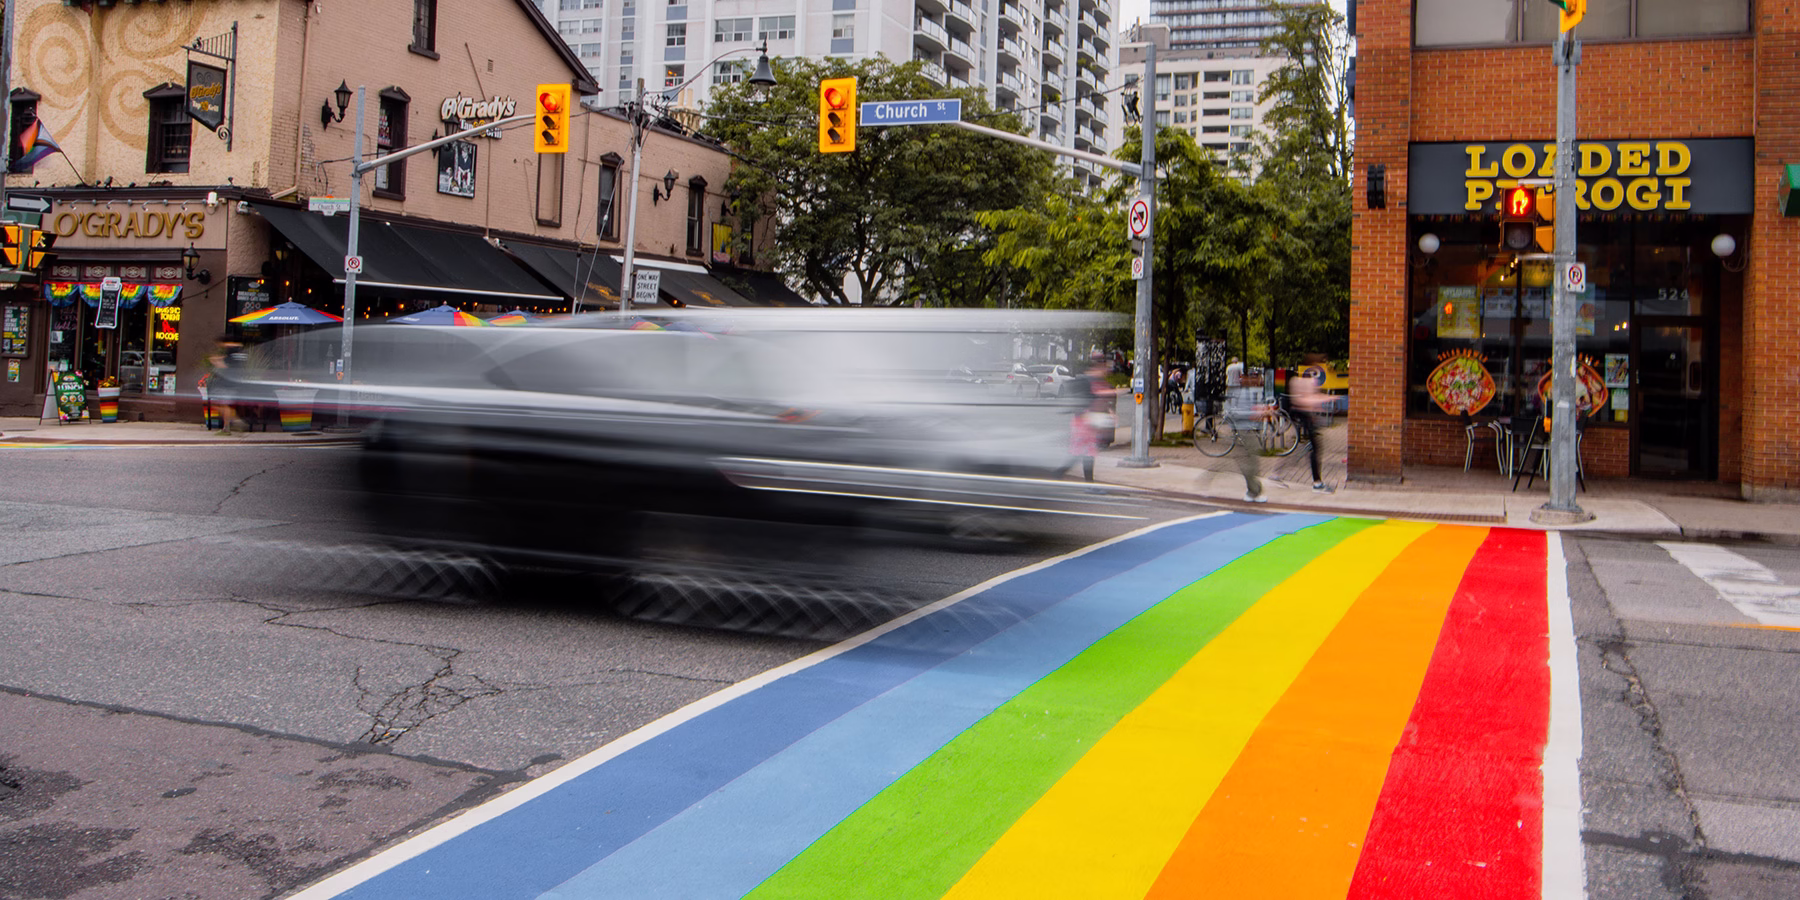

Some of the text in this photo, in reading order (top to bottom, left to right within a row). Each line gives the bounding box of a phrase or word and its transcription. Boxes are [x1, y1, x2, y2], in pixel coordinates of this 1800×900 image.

[441, 95, 516, 122] O'Grady's
[876, 102, 946, 119] Church St
[1465, 141, 1692, 178] LOADED
[1465, 177, 1692, 211] PROGI
[53, 211, 205, 239] O'GRADY'S
[637, 273, 659, 281] ONE WAY
[636, 291, 656, 299] BEGINS
[1658, 288, 1689, 300] 524
